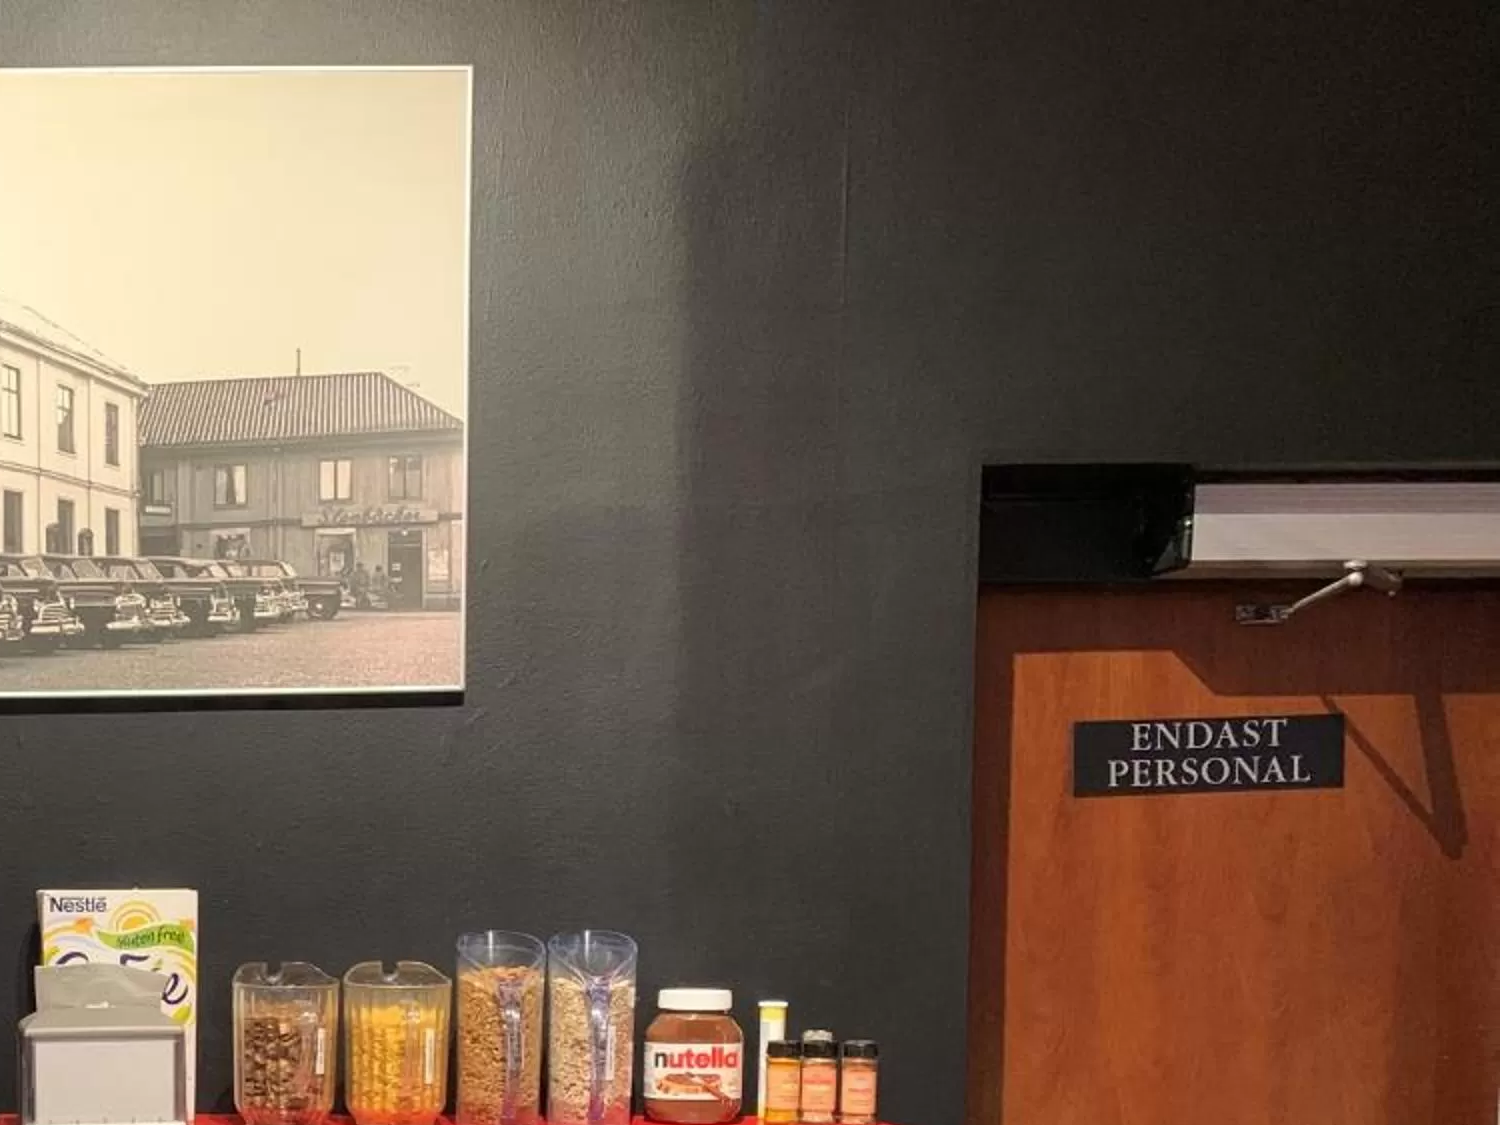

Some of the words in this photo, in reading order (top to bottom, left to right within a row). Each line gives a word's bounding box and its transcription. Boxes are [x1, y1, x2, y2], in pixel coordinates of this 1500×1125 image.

[1131, 718, 1288, 751] ENDAST
[1107, 754, 1312, 787] PERSONAL
[654, 1047, 739, 1069] nutella
